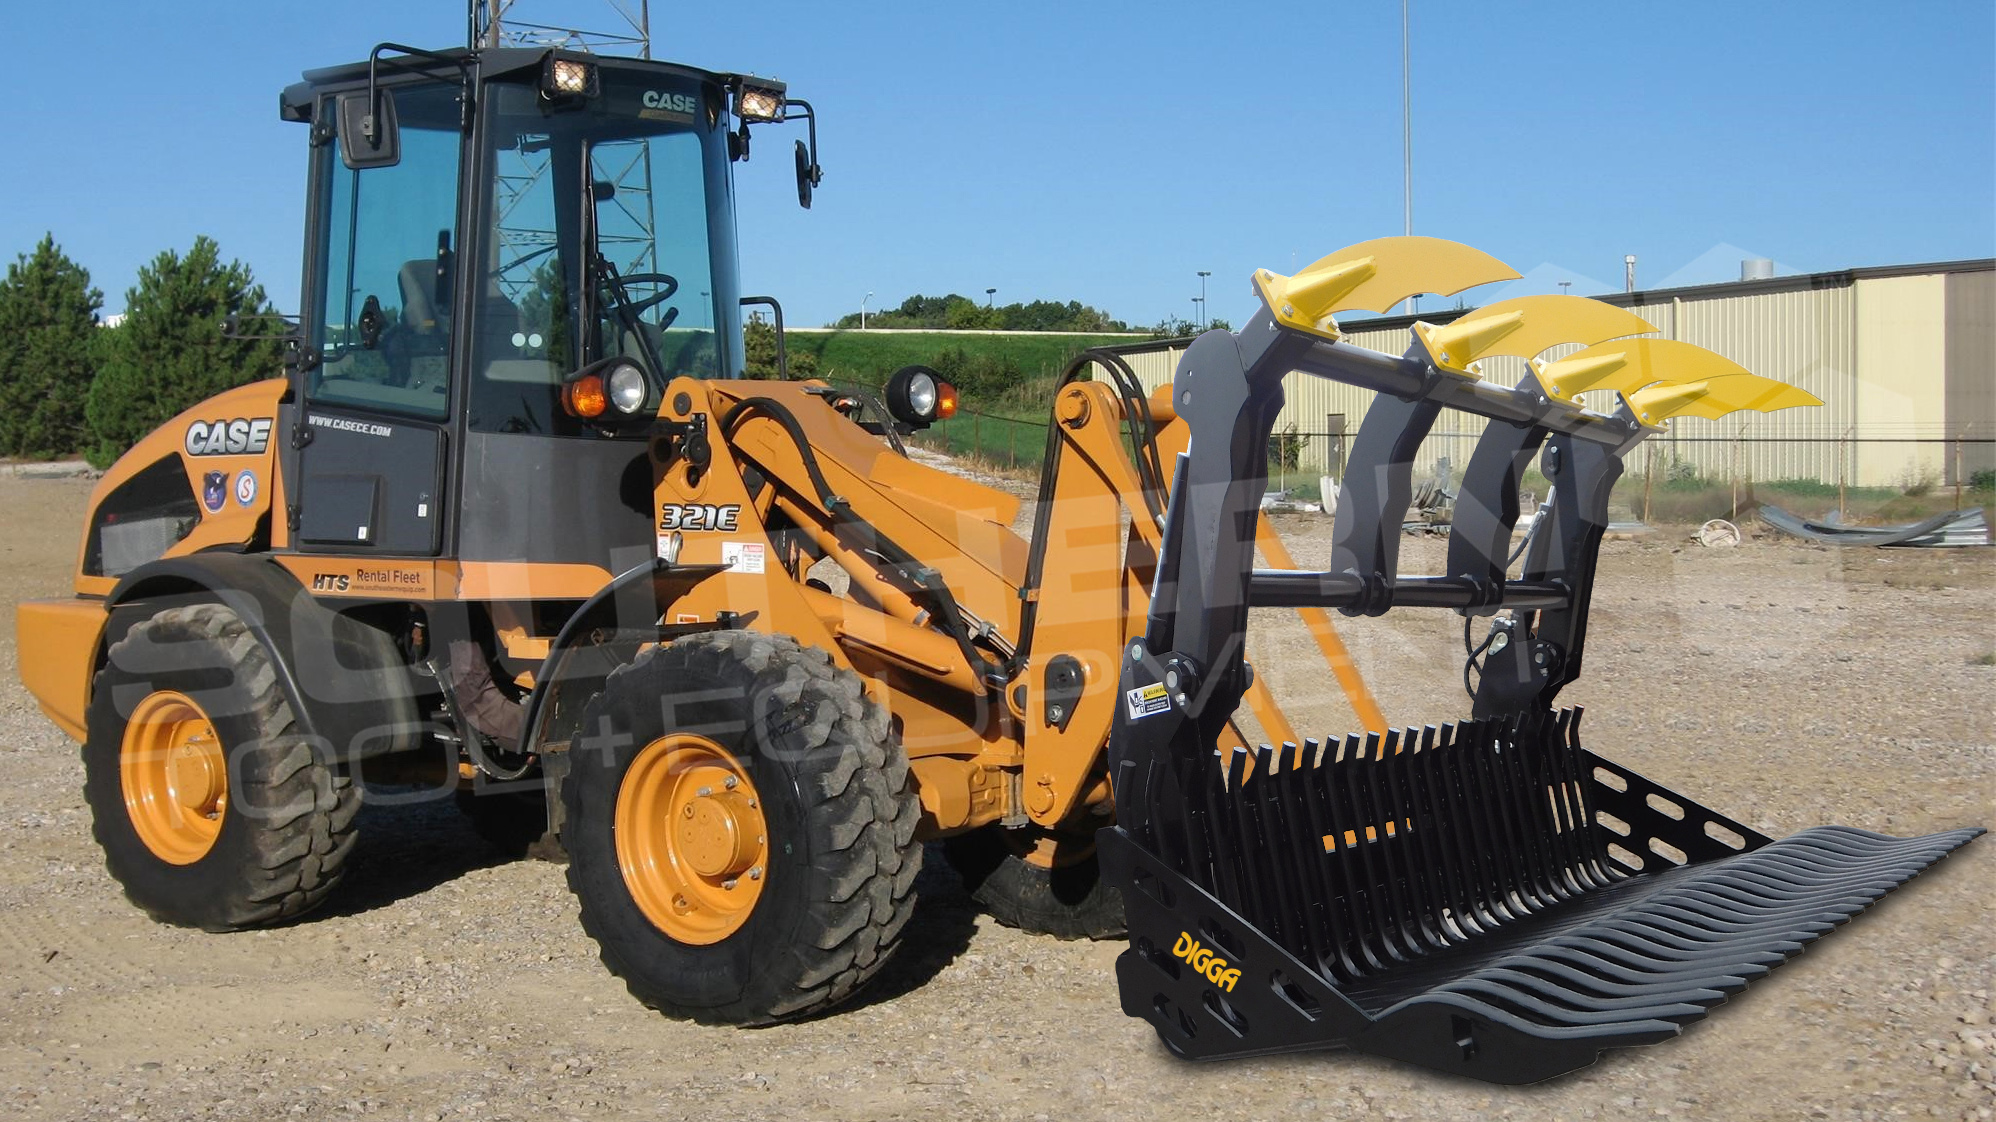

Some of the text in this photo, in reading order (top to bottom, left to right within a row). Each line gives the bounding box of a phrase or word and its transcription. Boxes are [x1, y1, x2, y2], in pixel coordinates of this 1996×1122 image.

[643, 90, 696, 114] CASE
[184, 418, 273, 456] CASE
[308, 415, 392, 438] WWW.CASECE.COM
[660, 504, 741, 531] 321E
[313, 573, 349, 592] HTS
[357, 568, 420, 584] Rental Fleet
[1172, 931, 1242, 993] DIGGA
